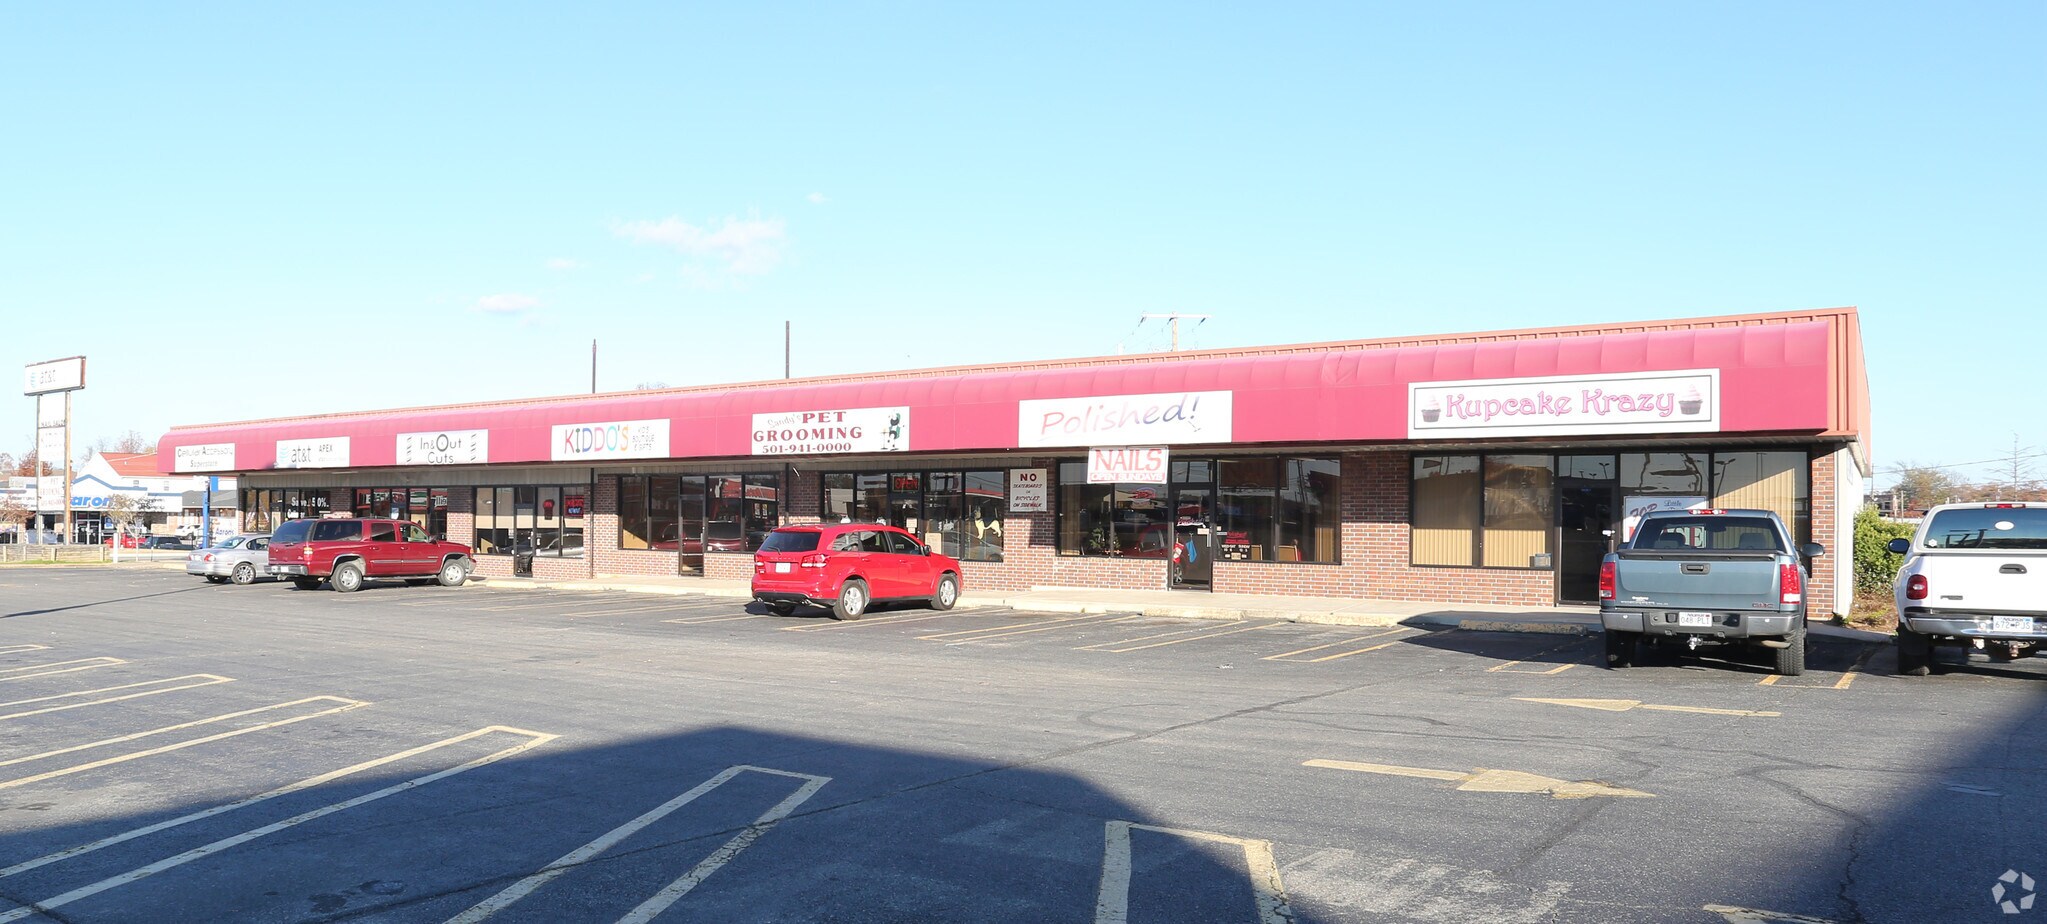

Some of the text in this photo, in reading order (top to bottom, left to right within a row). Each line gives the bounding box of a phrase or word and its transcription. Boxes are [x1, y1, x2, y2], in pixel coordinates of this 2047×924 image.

[1446, 388, 1674, 422] Kupcake Krazy
[767, 411, 847, 428] Sandy's PET
[1041, 394, 1200, 436] Polished!
[564, 424, 629, 454] KIDDO'S
[753, 426, 862, 442] GROOMING
[177, 447, 201, 458] Cellular
[291, 445, 311, 463] at&t
[318, 444, 333, 453] APEX
[762, 442, 852, 454] 501-941-0000
[427, 451, 454, 463] Cuts
[1094, 448, 1163, 472] NAILS
[895, 477, 918, 489] OPEN
[1020, 473, 1037, 481] NO
[1091, 472, 1164, 481] OPEN SUNDAYS
